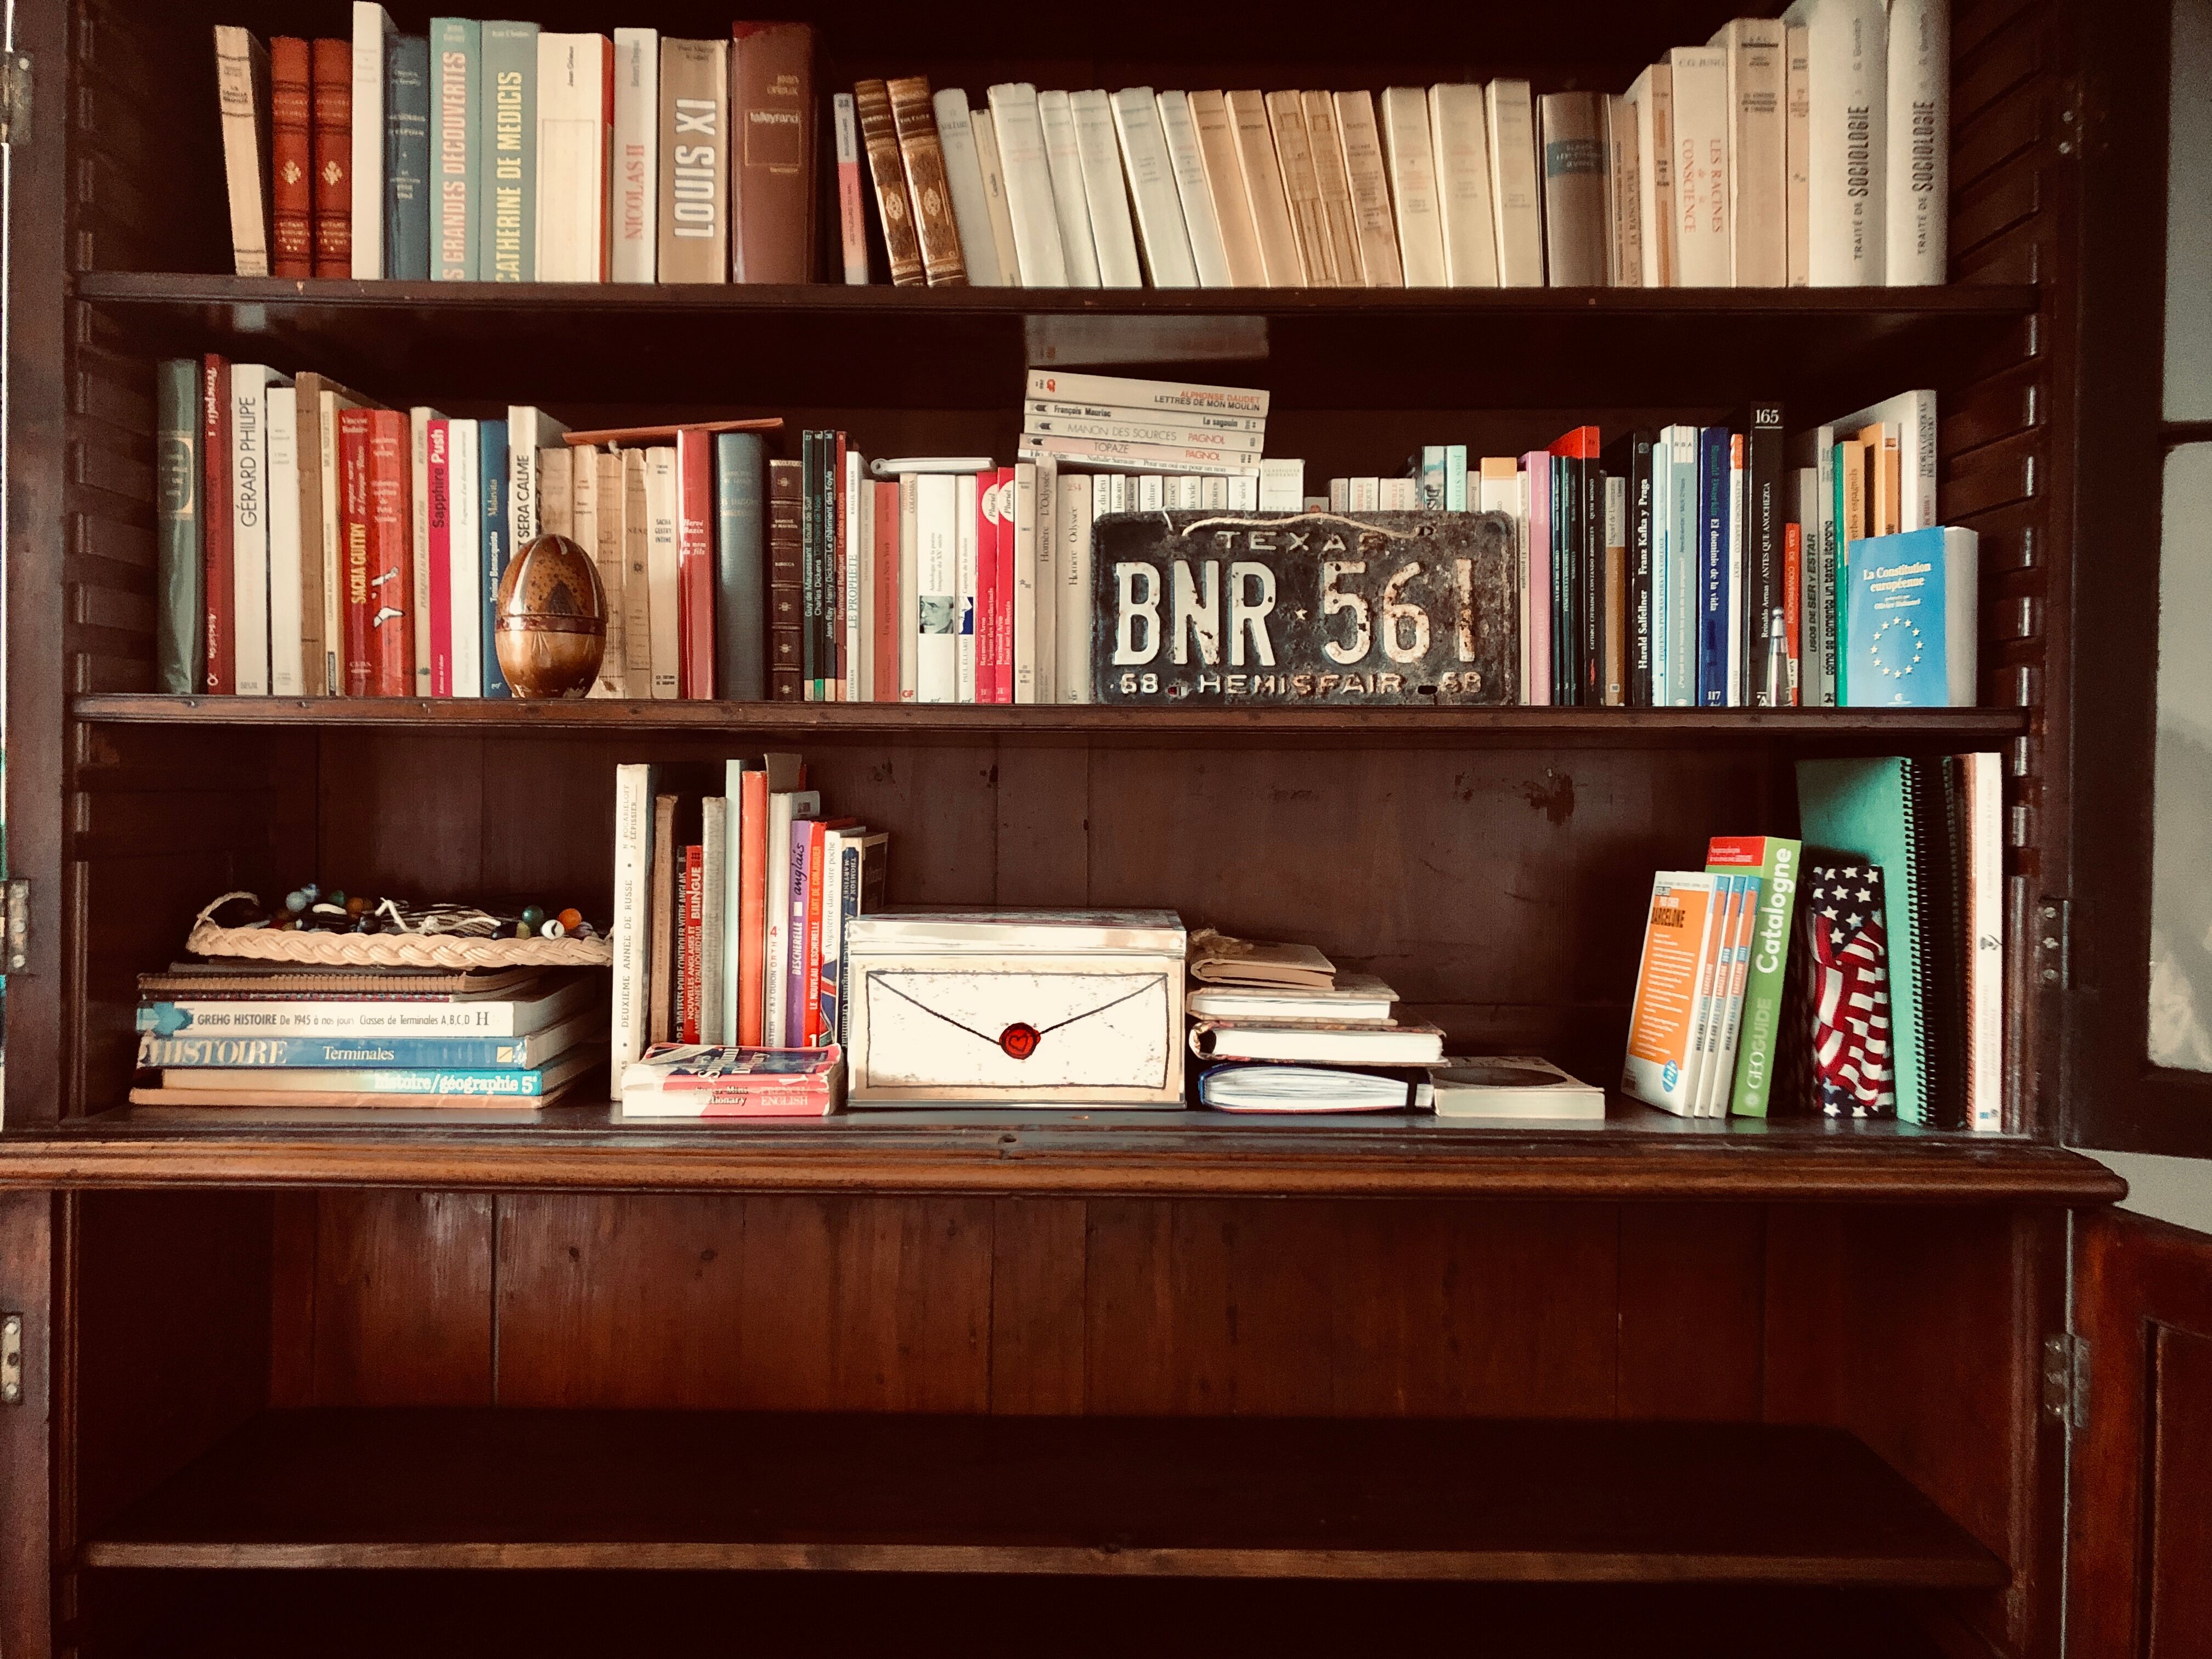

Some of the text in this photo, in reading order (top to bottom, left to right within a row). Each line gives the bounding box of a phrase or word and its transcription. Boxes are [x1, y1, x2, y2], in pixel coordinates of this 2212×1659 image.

[675, 98, 716, 136] XI
[1847, 106, 1869, 197] SOCIOLOGIE
[1912, 101, 1934, 192] SOCIOLOGIE
[497, 157, 521, 179] DE
[625, 144, 645, 240] NICOLAS II
[674, 145, 715, 237] LOUIS
[1682, 139, 1696, 234] CONSCIENCE
[1711, 170, 1724, 233] RACINES
[442, 181, 466, 262] GRANDES
[495, 187, 521, 282] CATHERINE
[1154, 395, 1260, 411] LETTRES DE MON MOULIN
[1181, 390, 1260, 404] ALPHONSE DAUDET
[1053, 405, 1111, 417] François Mauriac
[1203, 416, 1238, 428] Le sagouin
[1755, 409, 1780, 424] 165
[1067, 423, 1177, 441] MANON DES SOURCES
[1188, 433, 1226, 445] PAGNOL
[236, 397, 257, 527] GÉRARD PHILIPE
[1094, 442, 1221, 461] TOPAZE PAGNOL
[431, 429, 445, 528] Sapphire Push
[1453, 455, 1462, 476] JOHN
[825, 471, 834, 490] Foyle
[1098, 479, 1107, 505] du feu
[1849, 468, 1859, 512] espagnols
[517, 455, 529, 538] SERA CALME
[825, 492, 833, 505] des
[988, 493, 996, 517] Pluriel
[825, 506, 833, 542] châtiment
[1040, 472, 1052, 562] Homère L'Odyssée
[1711, 518, 1720, 529] El
[825, 544, 833, 552] Le
[1068, 508, 1079, 585] Homère Odyssée
[1217, 531, 1386, 551] TEXAS
[1710, 530, 1720, 567] dominio
[1807, 533, 1816, 574] ESTAR
[805, 547, 813, 590] Maupassant
[1638, 478, 1650, 669] Harald Salfellner Franz Kafka Praga
[1710, 568, 1719, 579] de
[1760, 483, 1771, 638] Reinaldo Arenas ANTES QUE ANOCHEZCA
[1863, 561, 1931, 580] La Constitution
[351, 567, 366, 603] SACHA
[825, 584, 834, 603] Harry
[836, 554, 845, 620] Raymond Radiguet
[1710, 581, 1719, 590] la
[1807, 584, 1816, 609] SER
[1870, 577, 1925, 592] européenne
[805, 602, 813, 617] Guy
[1710, 592, 1719, 611] vida
[1822, 520, 1834, 676] cómo se comenta un texto literario
[825, 607, 834, 620] Ray
[848, 614, 857, 629] LE
[1114, 560, 1276, 666] BNR
[1323, 558, 1475, 664] 561
[1120, 672, 1159, 694] 68
[1200, 671, 1413, 694] HEMISFAIR
[1707, 691, 1721, 700] 117
[825, 842, 837, 907] dans votre poche
[686, 866, 701, 919] BILINGUE
[791, 842, 808, 975] BESCHERELLE anglais
[1756, 848, 1795, 973] Catalogne
[623, 916, 631, 929] DE
[770, 926, 777, 937] 4
[809, 845, 820, 1010] LE NOUVEAU BESCHERELLE L'ART CONJUGUER
[622, 935, 631, 969] ANNÉE
[694, 926, 702, 983] D'AUJOURD'HUI
[687, 926, 696, 1019] NOUVELLES ANGLAISES ET
[198, 1014, 231, 1025] GREHG
[234, 1014, 277, 1025] HISTOIRE
[280, 1015, 290, 1025] De
[294, 1015, 311, 1025] 1945
[336, 1015, 355, 1027] jours
[359, 1014, 385, 1025] Classes
[388, 1014, 397, 1025] de
[399, 1014, 438, 1025] Terminales
[476, 1011, 490, 1025] H
[322, 1046, 394, 1060] Terminales
[760, 1095, 808, 1105] ENGLISH
